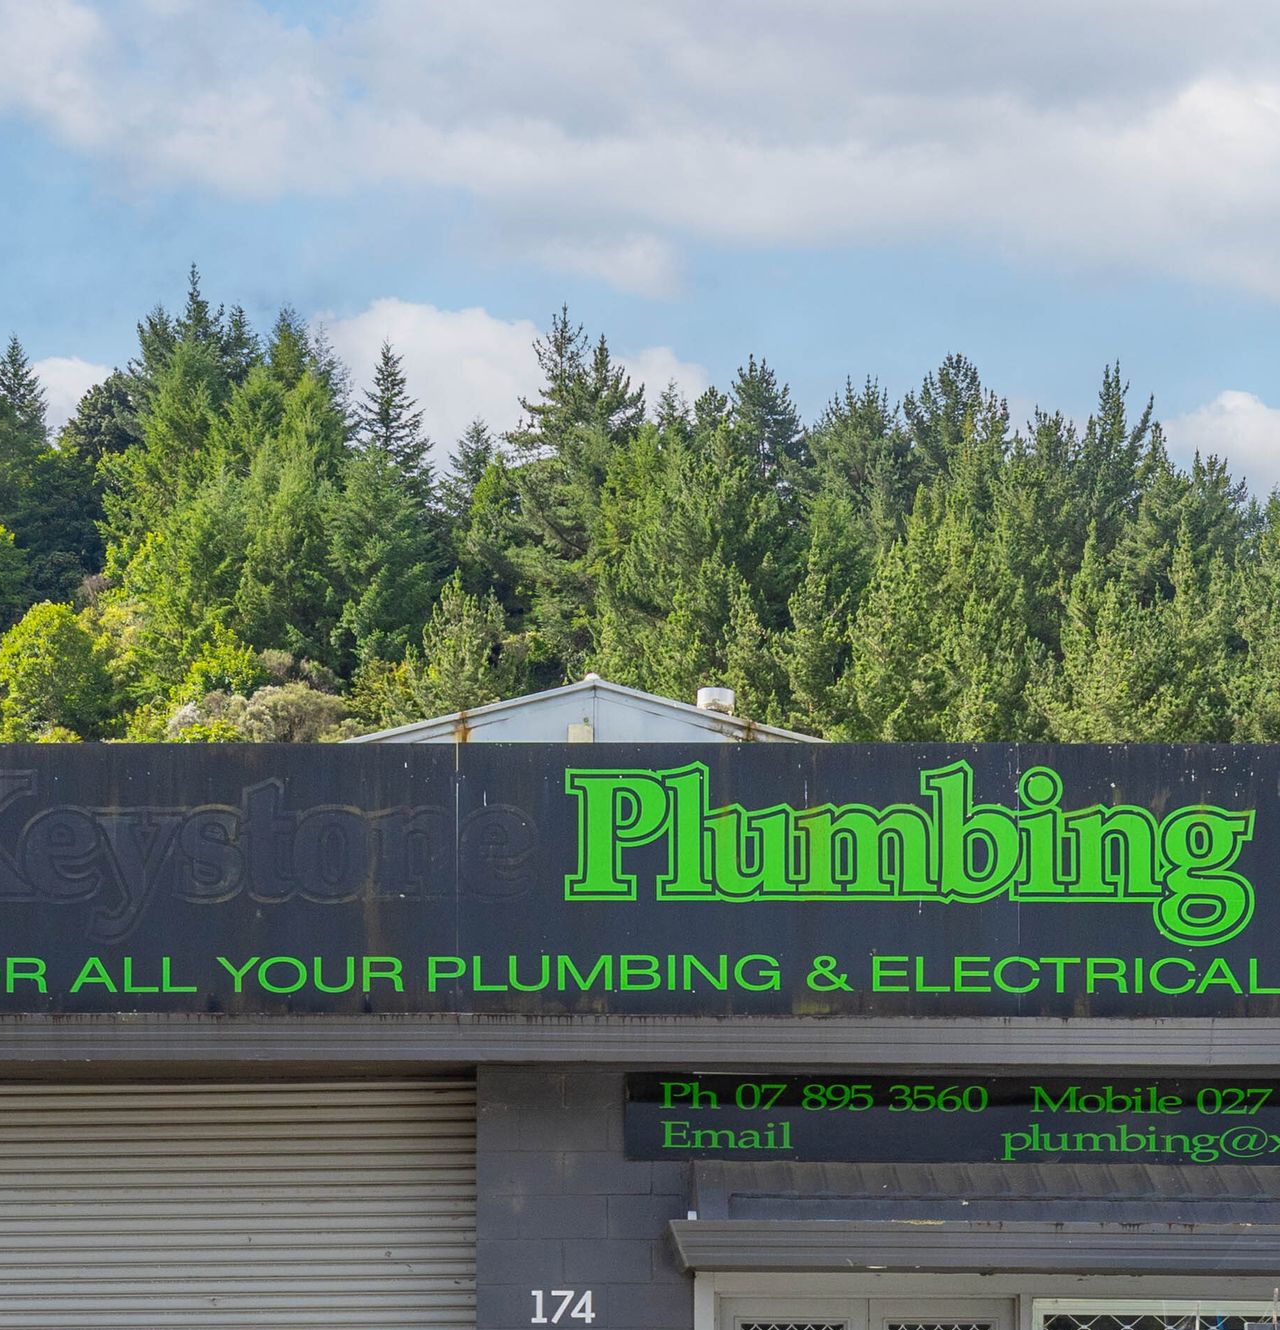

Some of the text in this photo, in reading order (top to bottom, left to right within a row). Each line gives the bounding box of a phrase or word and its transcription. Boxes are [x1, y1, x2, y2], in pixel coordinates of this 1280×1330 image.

[564, 760, 1256, 946] Plumbing
[71, 956, 197, 992] ALL
[218, 956, 403, 993] YOUR
[428, 954, 781, 993] PLUMBING
[806, 955, 853, 992] &
[661, 1081, 719, 1111] Ph
[735, 1083, 787, 1111] 07
[801, 1083, 874, 1111] 895
[889, 1084, 989, 1112] 3560
[1031, 1084, 1184, 1114] Mobile
[1197, 1087, 1273, 1115] 027
[662, 1120, 793, 1150] Email
[531, 1290, 596, 1324] 174
